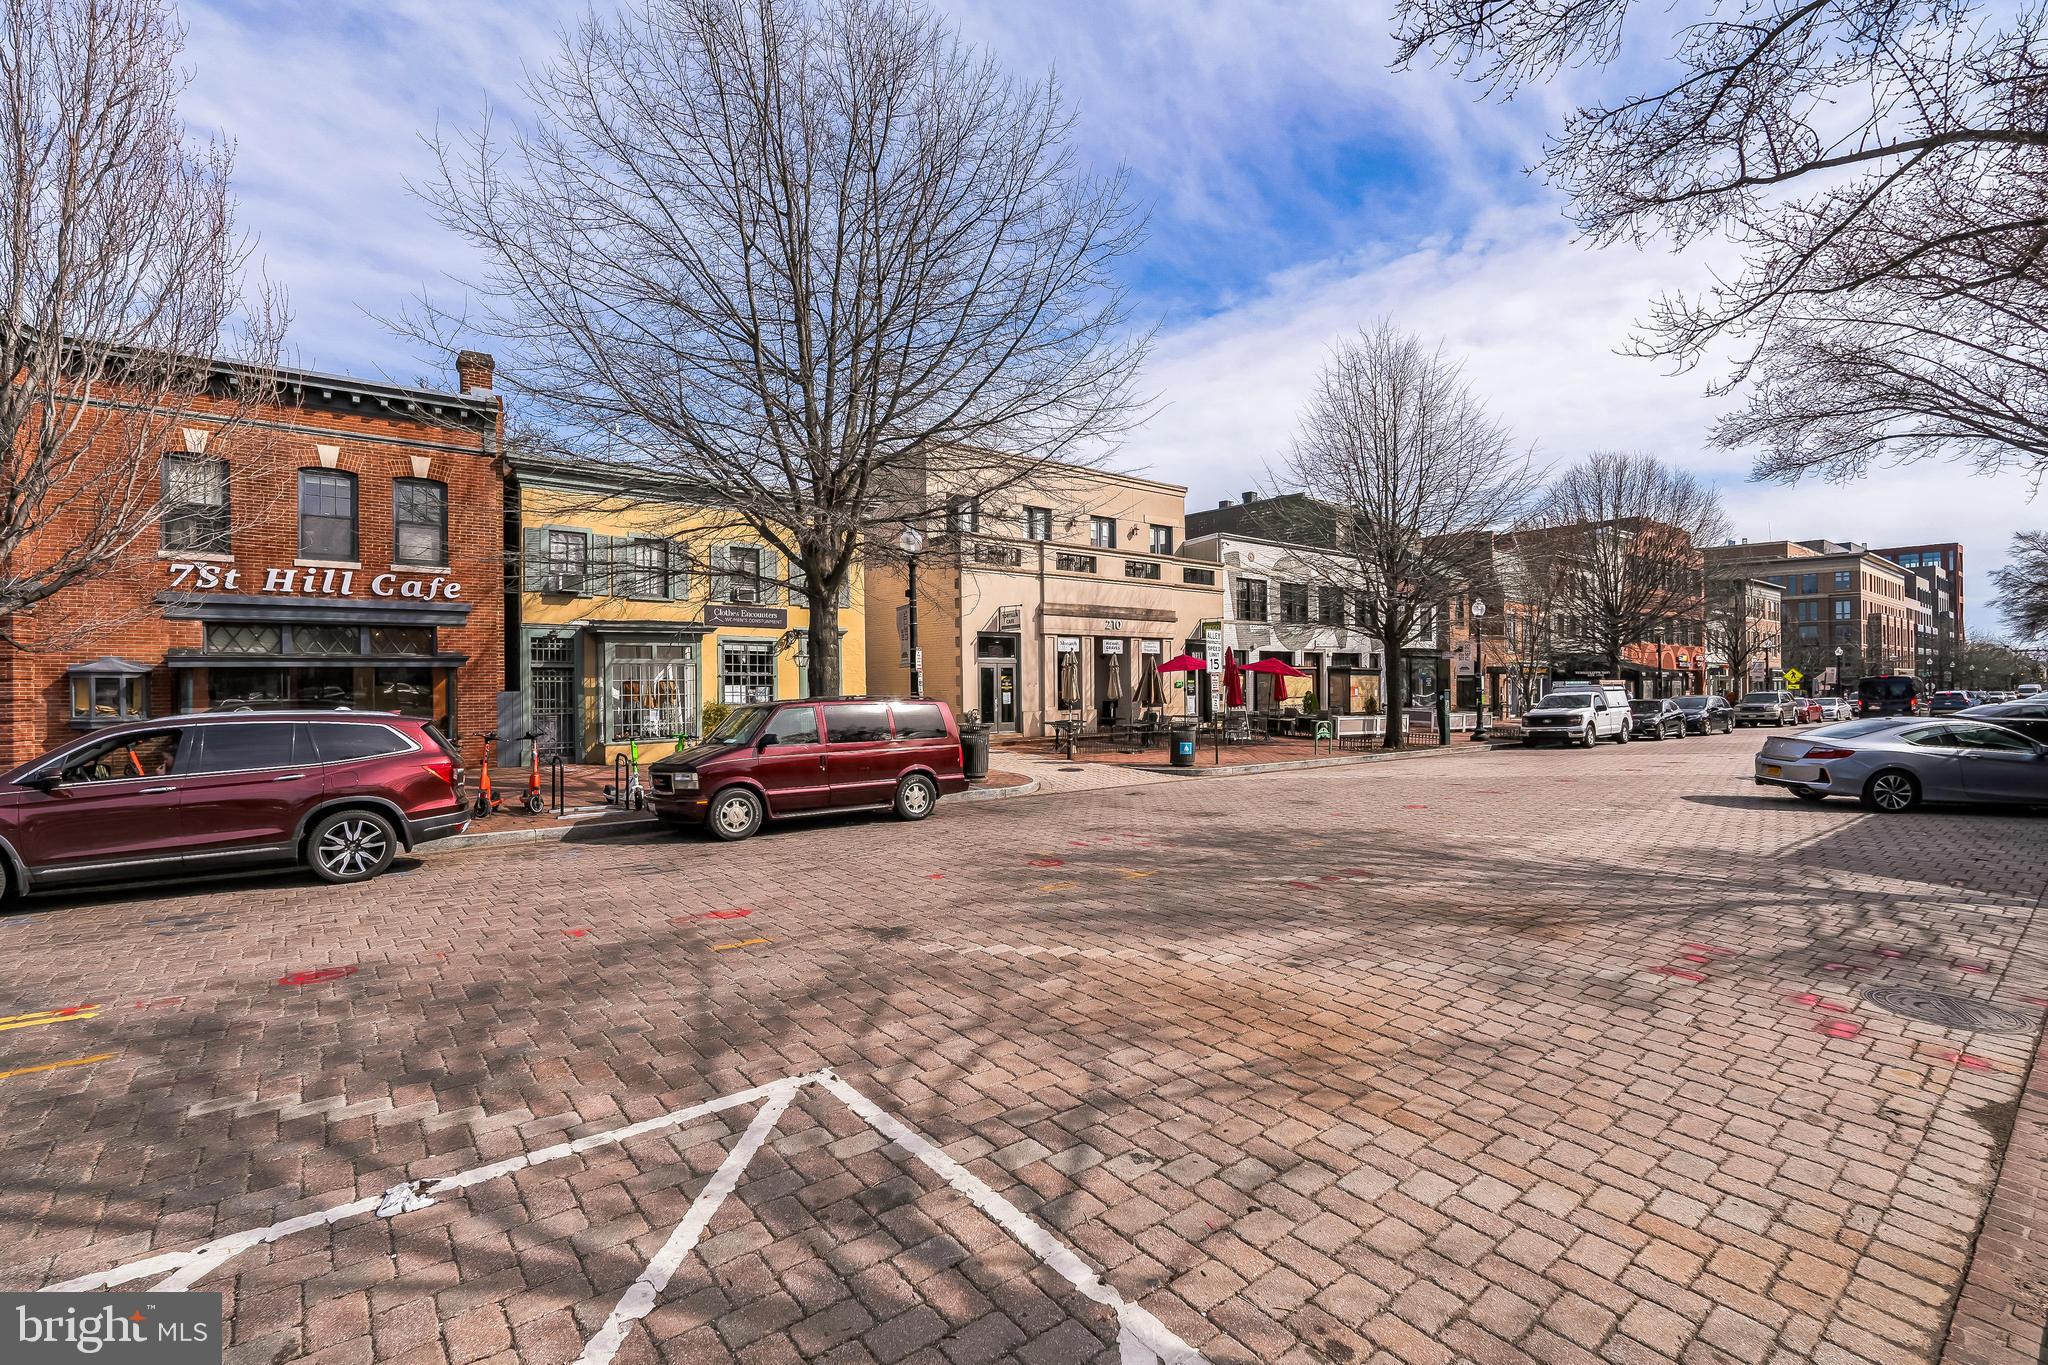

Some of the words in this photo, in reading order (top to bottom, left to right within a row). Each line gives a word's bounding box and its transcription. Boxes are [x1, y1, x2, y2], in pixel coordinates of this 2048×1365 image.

[262, 567, 354, 596] Hill
[371, 573, 461, 601] Cafe
[713, 608, 740, 617] Clothes
[741, 610, 778, 619] Encounters
[1104, 619, 1123, 631] 210
[1210, 658, 1220, 670] 15
